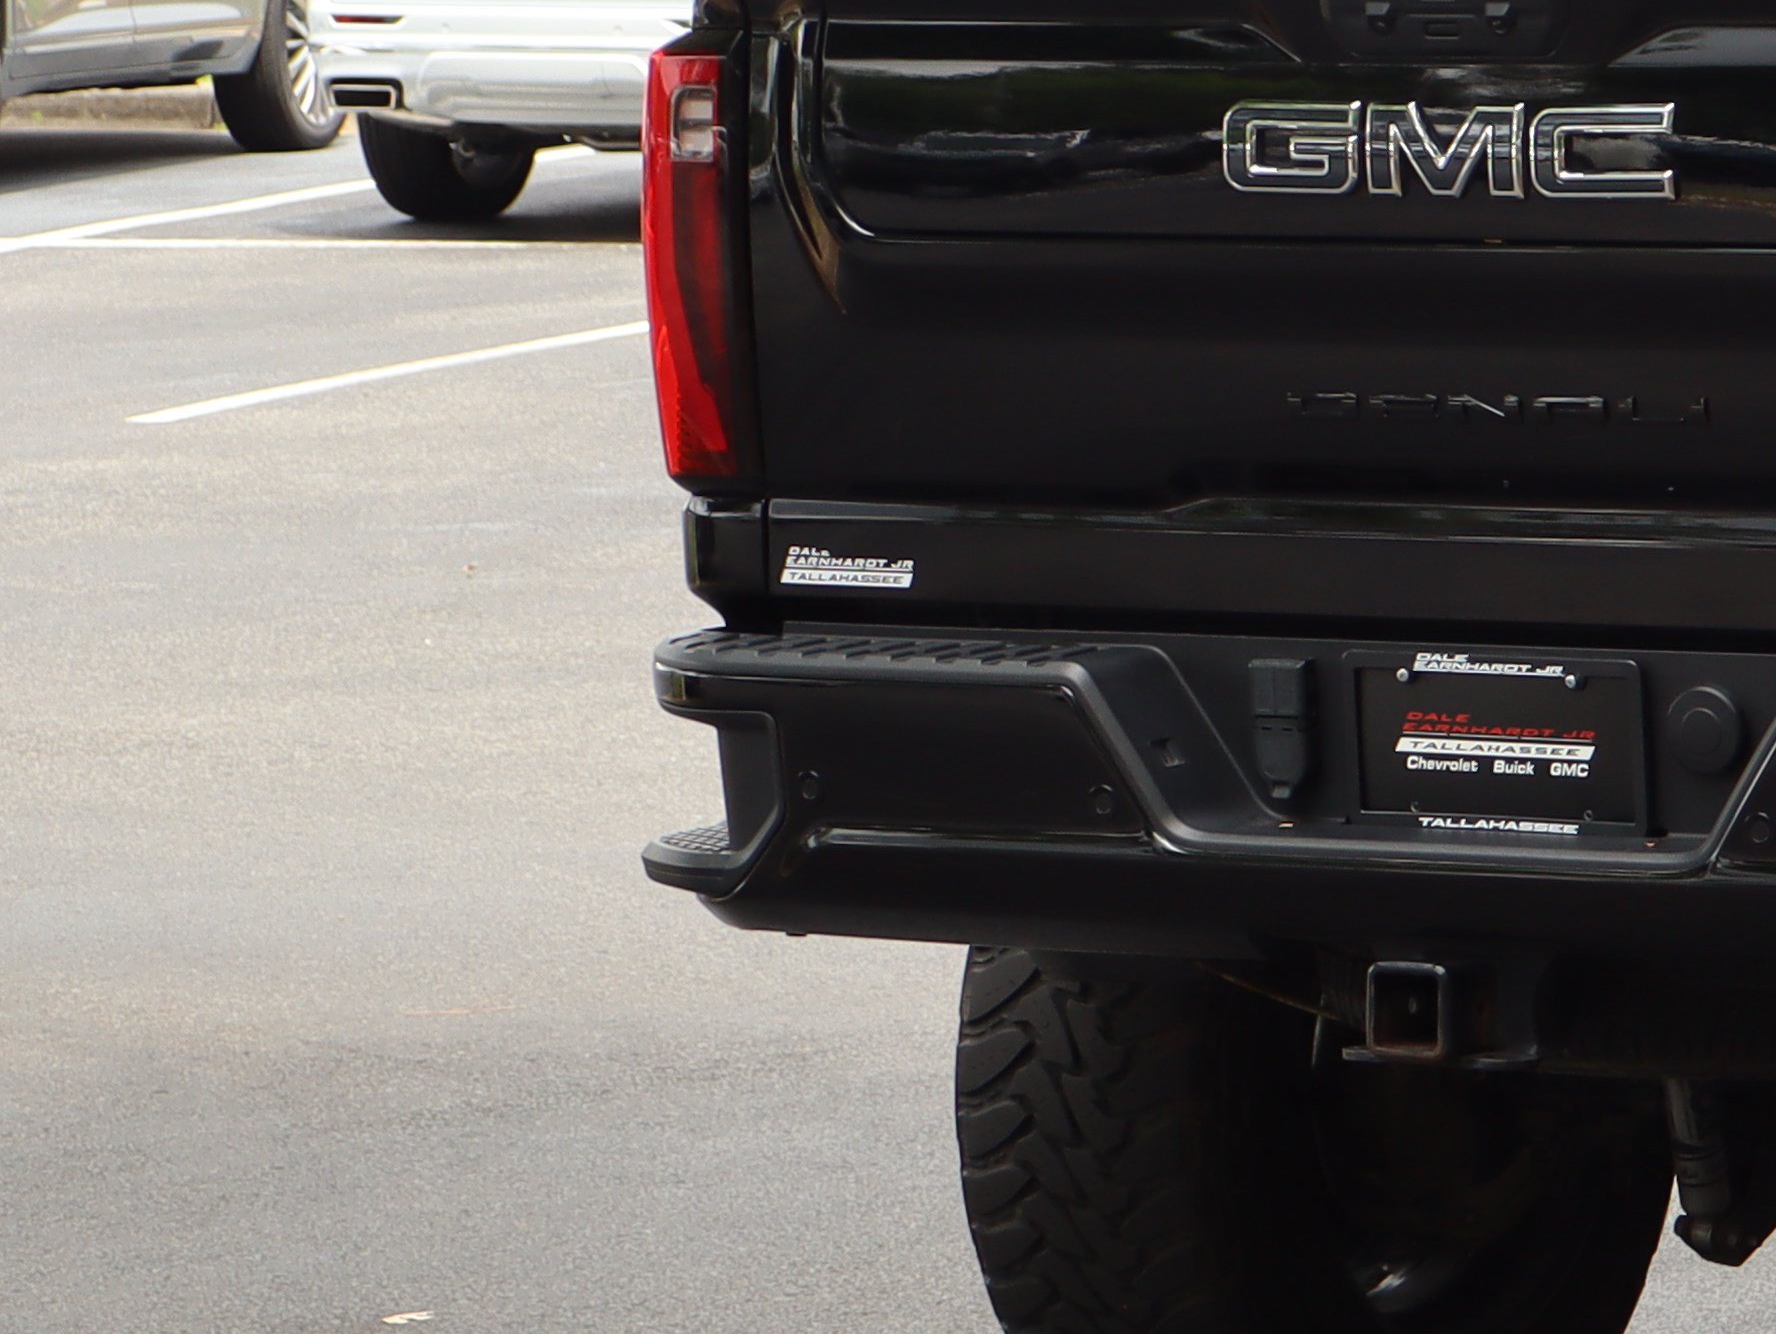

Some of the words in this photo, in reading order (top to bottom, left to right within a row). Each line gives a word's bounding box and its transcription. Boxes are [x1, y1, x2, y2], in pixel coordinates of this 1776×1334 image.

[1223, 100, 1676, 200] GMC
[785, 555, 888, 569] EARNHARDT
[890, 559, 914, 571] JR
[789, 571, 904, 585] TALLAHASSEE
[1416, 652, 1469, 662] DALE
[1412, 660, 1532, 673] EARNHARDT
[1535, 664, 1564, 676] JR
[1405, 711, 1471, 723] DALE
[1402, 722, 1555, 737] EARNHARDT
[1562, 729, 1596, 739] JR
[1410, 740, 1581, 757] TALLAHASSEE
[1406, 755, 1479, 773] Chevrolet
[1492, 759, 1535, 776] Buick
[1549, 762, 1590, 778] GMC
[1418, 817, 1580, 835] TALLAHASSEE
